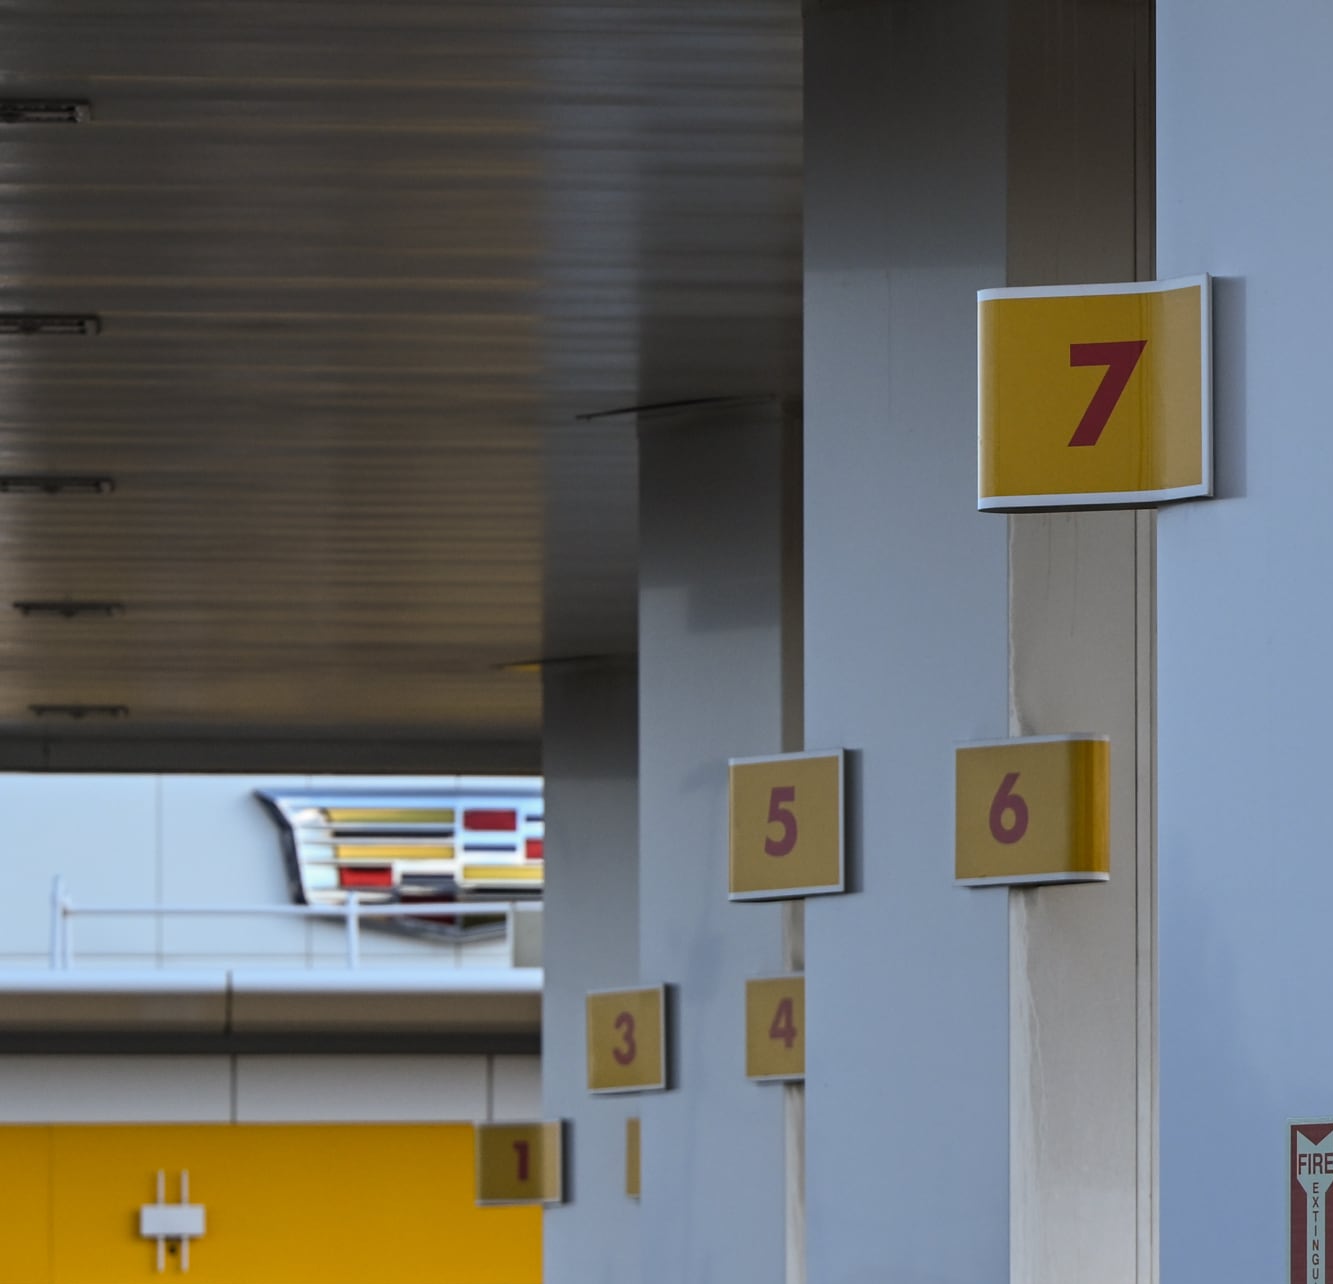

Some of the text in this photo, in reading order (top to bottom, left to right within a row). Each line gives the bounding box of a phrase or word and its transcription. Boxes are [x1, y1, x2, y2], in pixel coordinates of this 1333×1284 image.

[1068, 339, 1148, 447] 7
[764, 786, 798, 857] 5
[989, 772, 1029, 845] 6
[613, 1012, 636, 1065] 3
[769, 998, 797, 1049] 4
[513, 1141, 529, 1181] 1
